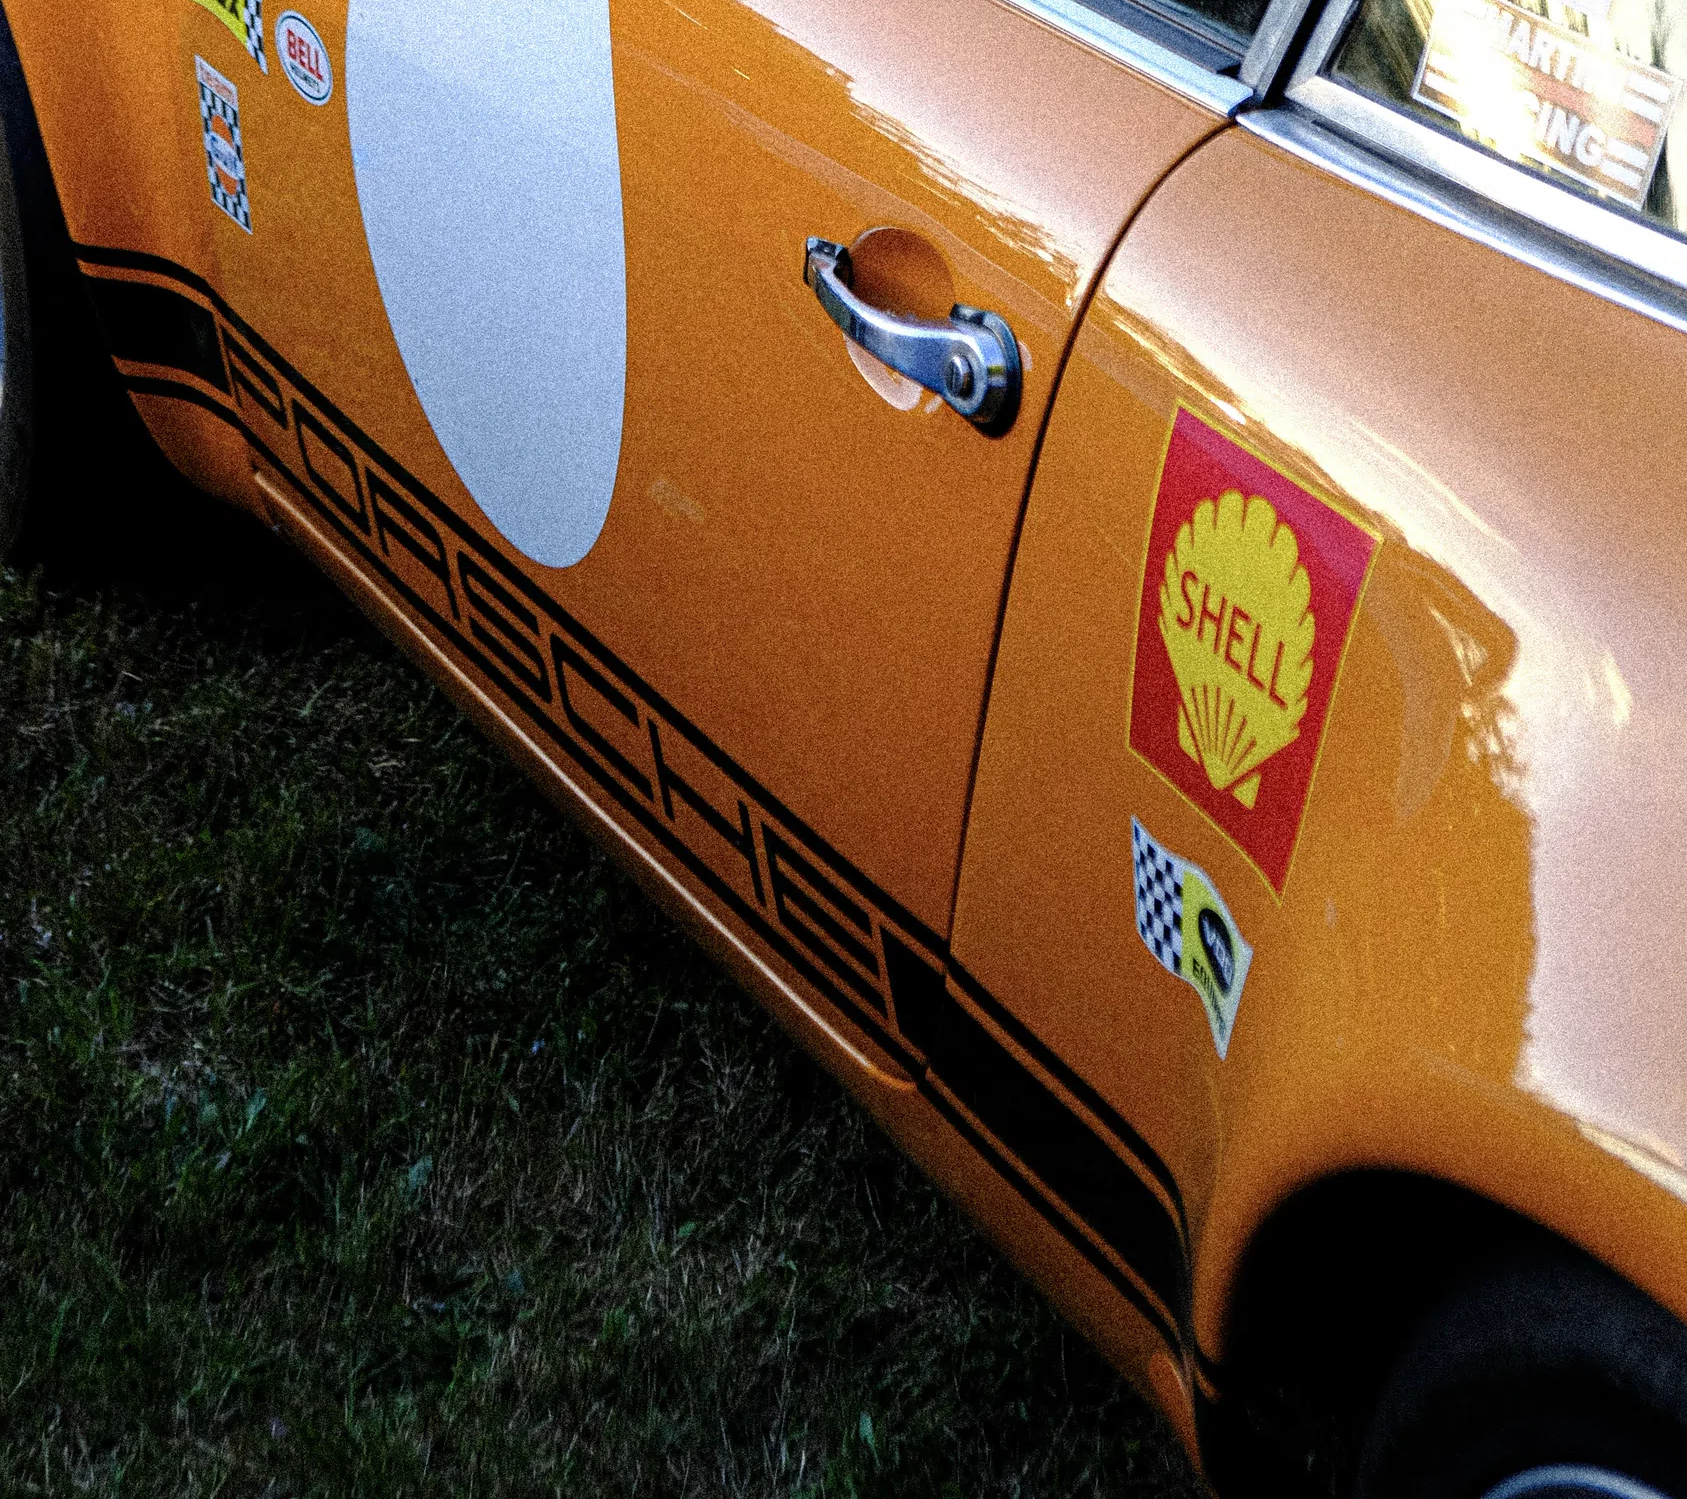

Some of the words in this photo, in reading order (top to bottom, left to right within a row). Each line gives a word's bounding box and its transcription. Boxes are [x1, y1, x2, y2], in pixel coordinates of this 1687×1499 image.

[286, 27, 324, 82] BELL
[220, 325, 891, 1021] PORSCHE
[1175, 570, 1290, 710] SHELL
